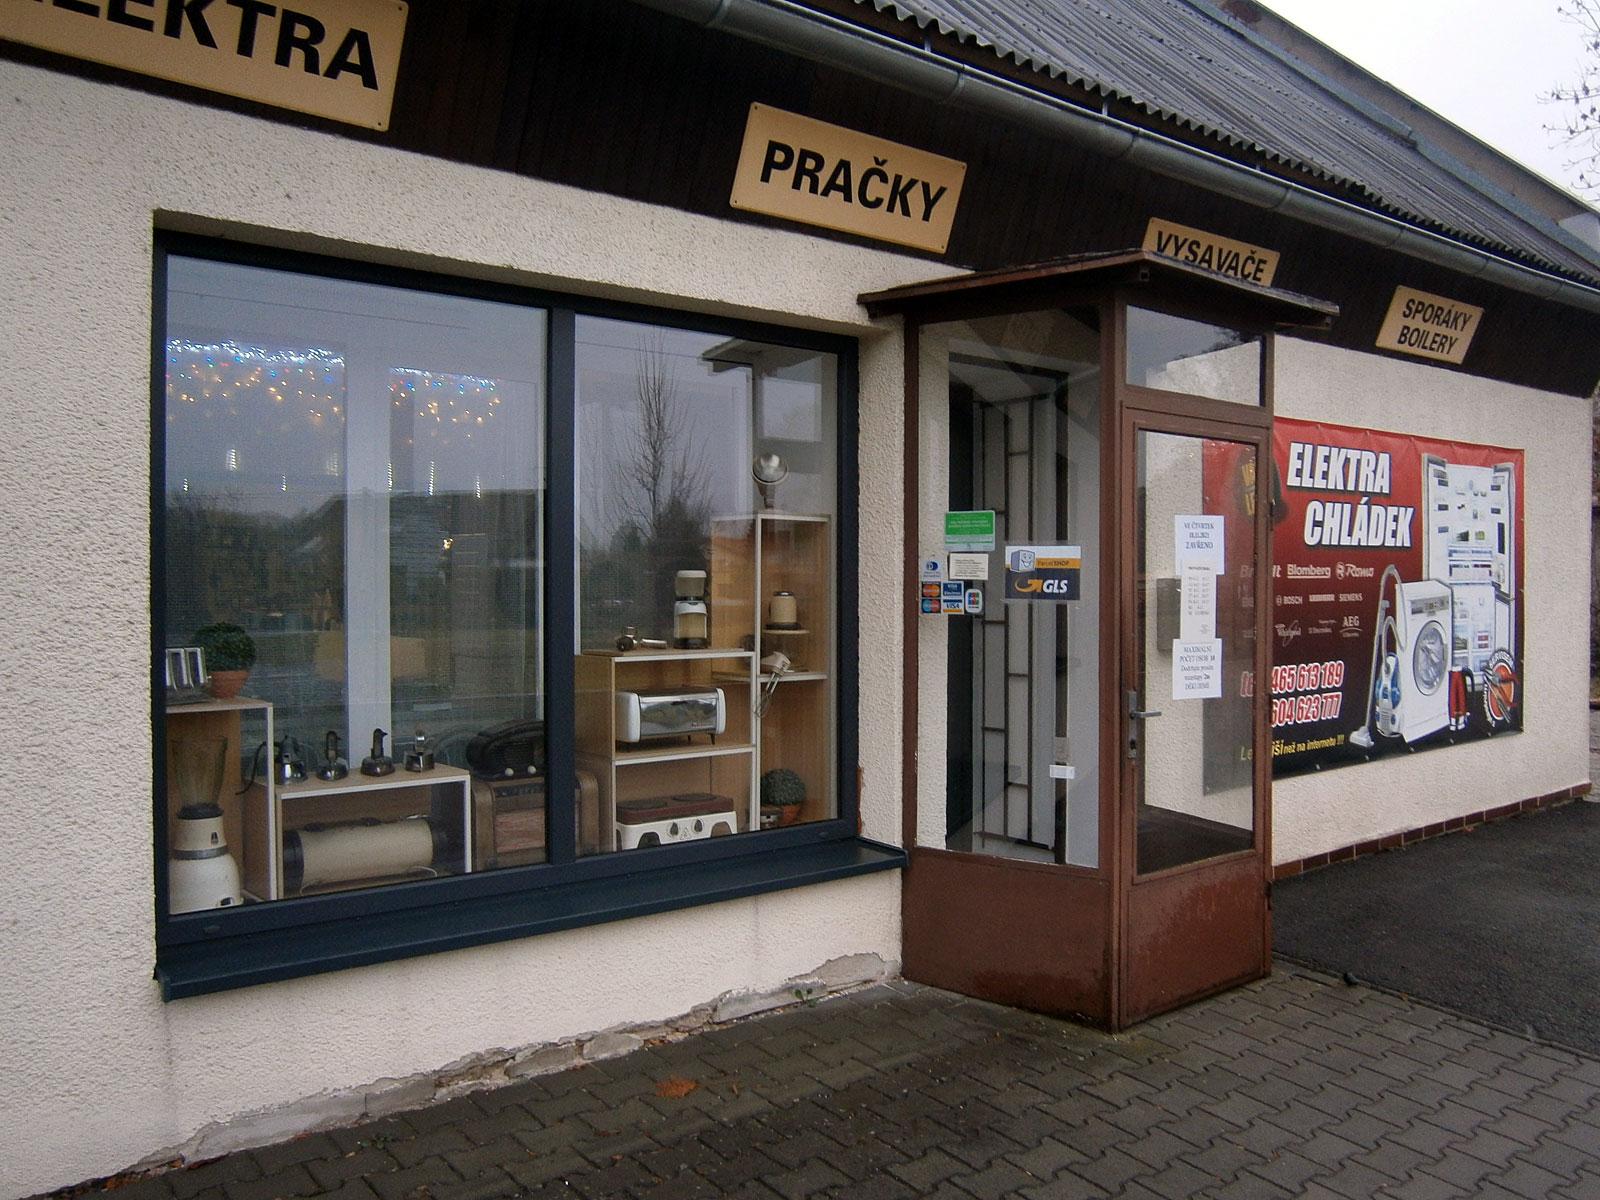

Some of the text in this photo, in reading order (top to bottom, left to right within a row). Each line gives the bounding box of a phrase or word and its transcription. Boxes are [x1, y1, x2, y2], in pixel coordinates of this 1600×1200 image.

[760, 140, 948, 223] PRAČKY
[1156, 230, 1268, 282] VYSAVAČE
[1402, 298, 1472, 332] SPORÁKY
[1397, 325, 1458, 355] BOILERY
[1287, 441, 1392, 494] ELEKTRA
[1303, 496, 1416, 547] CHLÁDEK
[1042, 579, 1068, 594] GLS
[1287, 563, 1331, 578] Blomberg
[1342, 615, 1360, 627] AEG
[1272, 665, 1296, 694] 465
[1296, 663, 1321, 691] 613
[1321, 660, 1344, 688] 189
[1272, 691, 1342, 728] 604 623 777
[1297, 742, 1306, 752] na
